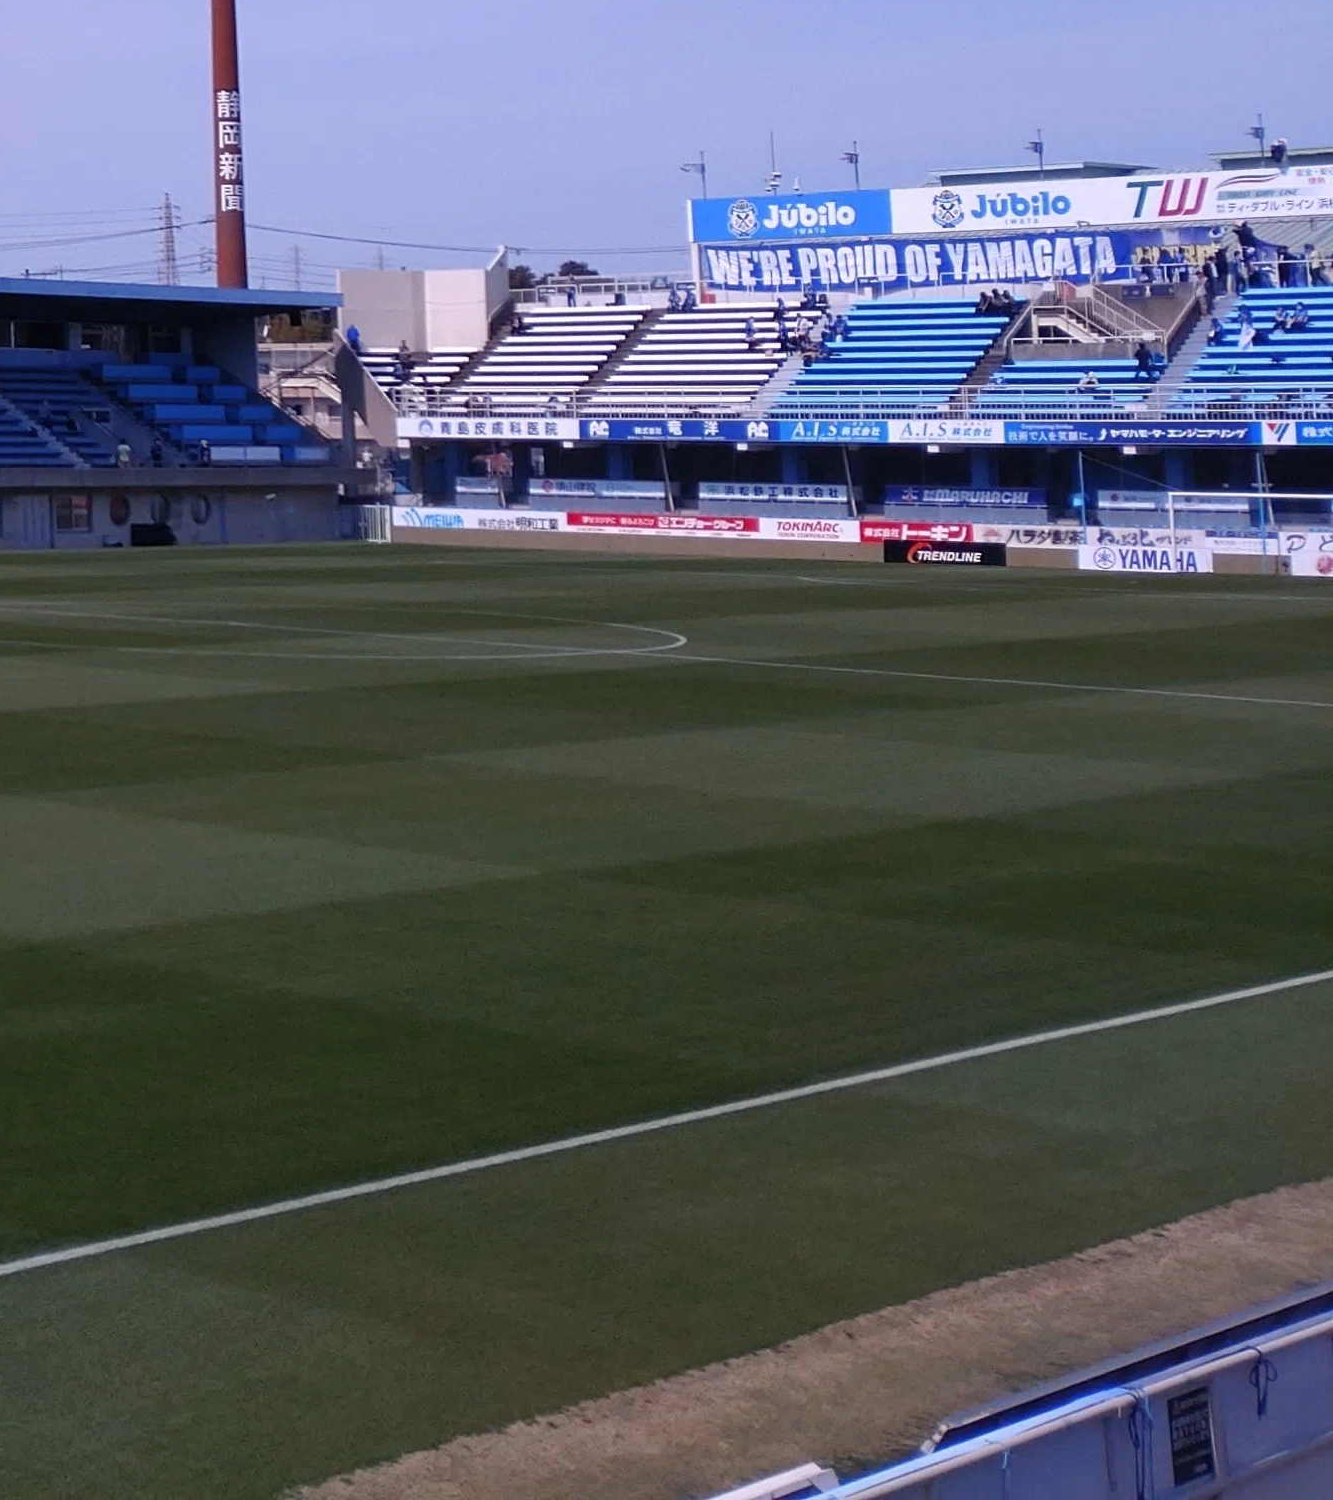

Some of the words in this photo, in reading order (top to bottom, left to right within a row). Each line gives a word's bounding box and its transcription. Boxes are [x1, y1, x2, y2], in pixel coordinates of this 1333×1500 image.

[217, 90, 244, 212] 静岡新聞
[763, 201, 856, 229] Júbilo
[971, 191, 1071, 219] Júbilo
[1005, 218, 1039, 226] IWATA
[707, 248, 796, 286] WE'RE
[797, 243, 898, 285] PROUD
[905, 243, 941, 283] OF
[946, 236, 1116, 281] YAMAGATA
[902, 525, 967, 541] トーキン
[916, 550, 983, 563] TRENDLINE
[1119, 548, 1198, 572] YAMAHA
